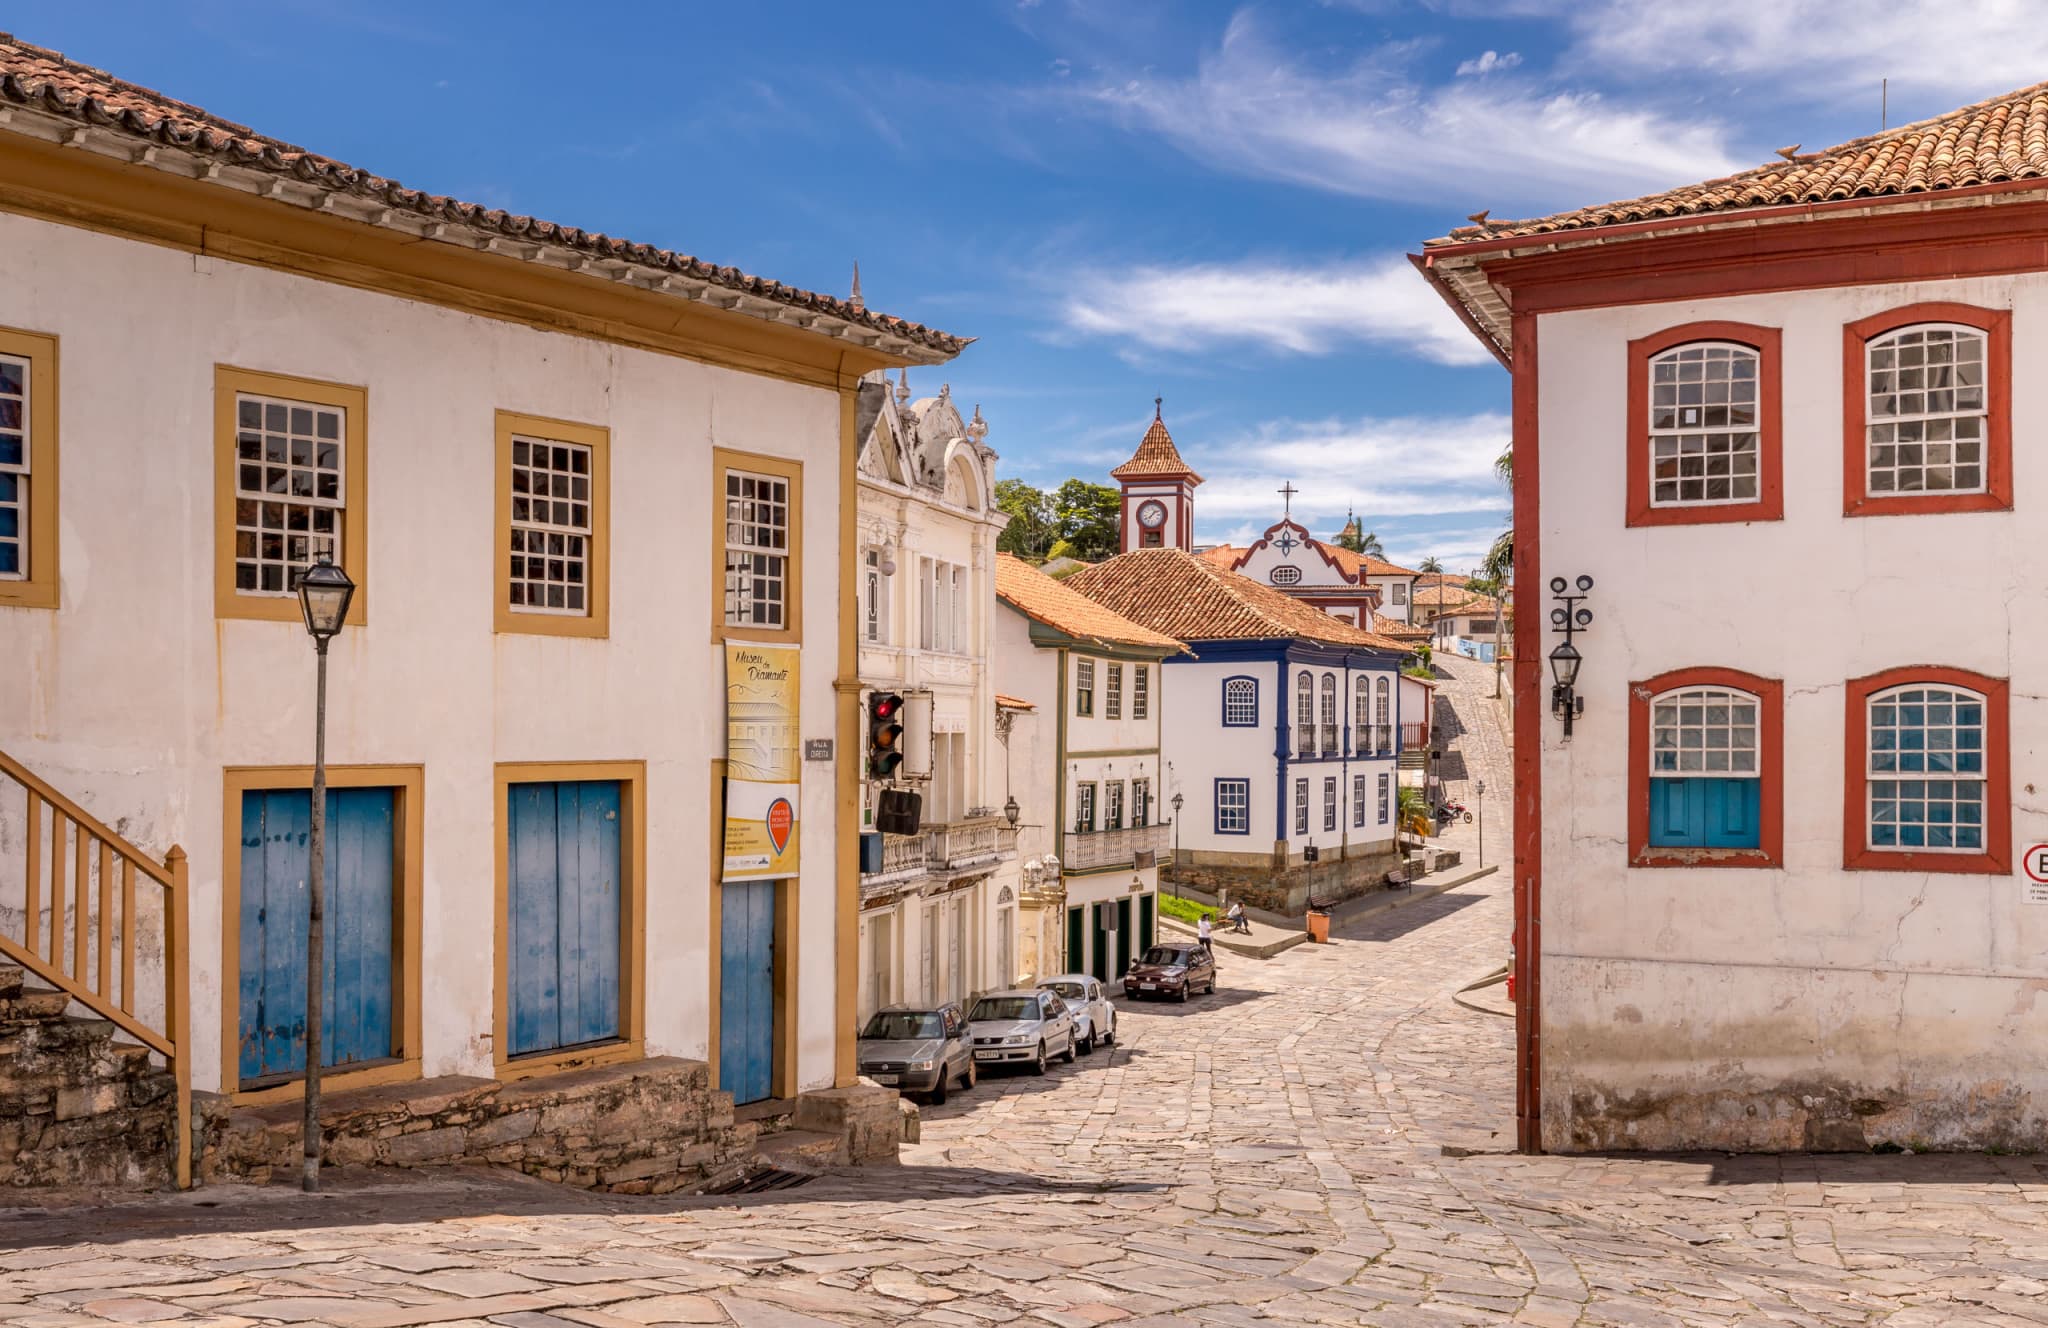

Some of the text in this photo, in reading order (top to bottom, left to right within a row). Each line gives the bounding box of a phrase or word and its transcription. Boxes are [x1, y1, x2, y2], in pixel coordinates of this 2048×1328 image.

[736, 651, 763, 664] Museu
[748, 666, 790, 681] Diamante
[811, 750, 829, 758] DIREITA
[2039, 853, 2048, 874] E
